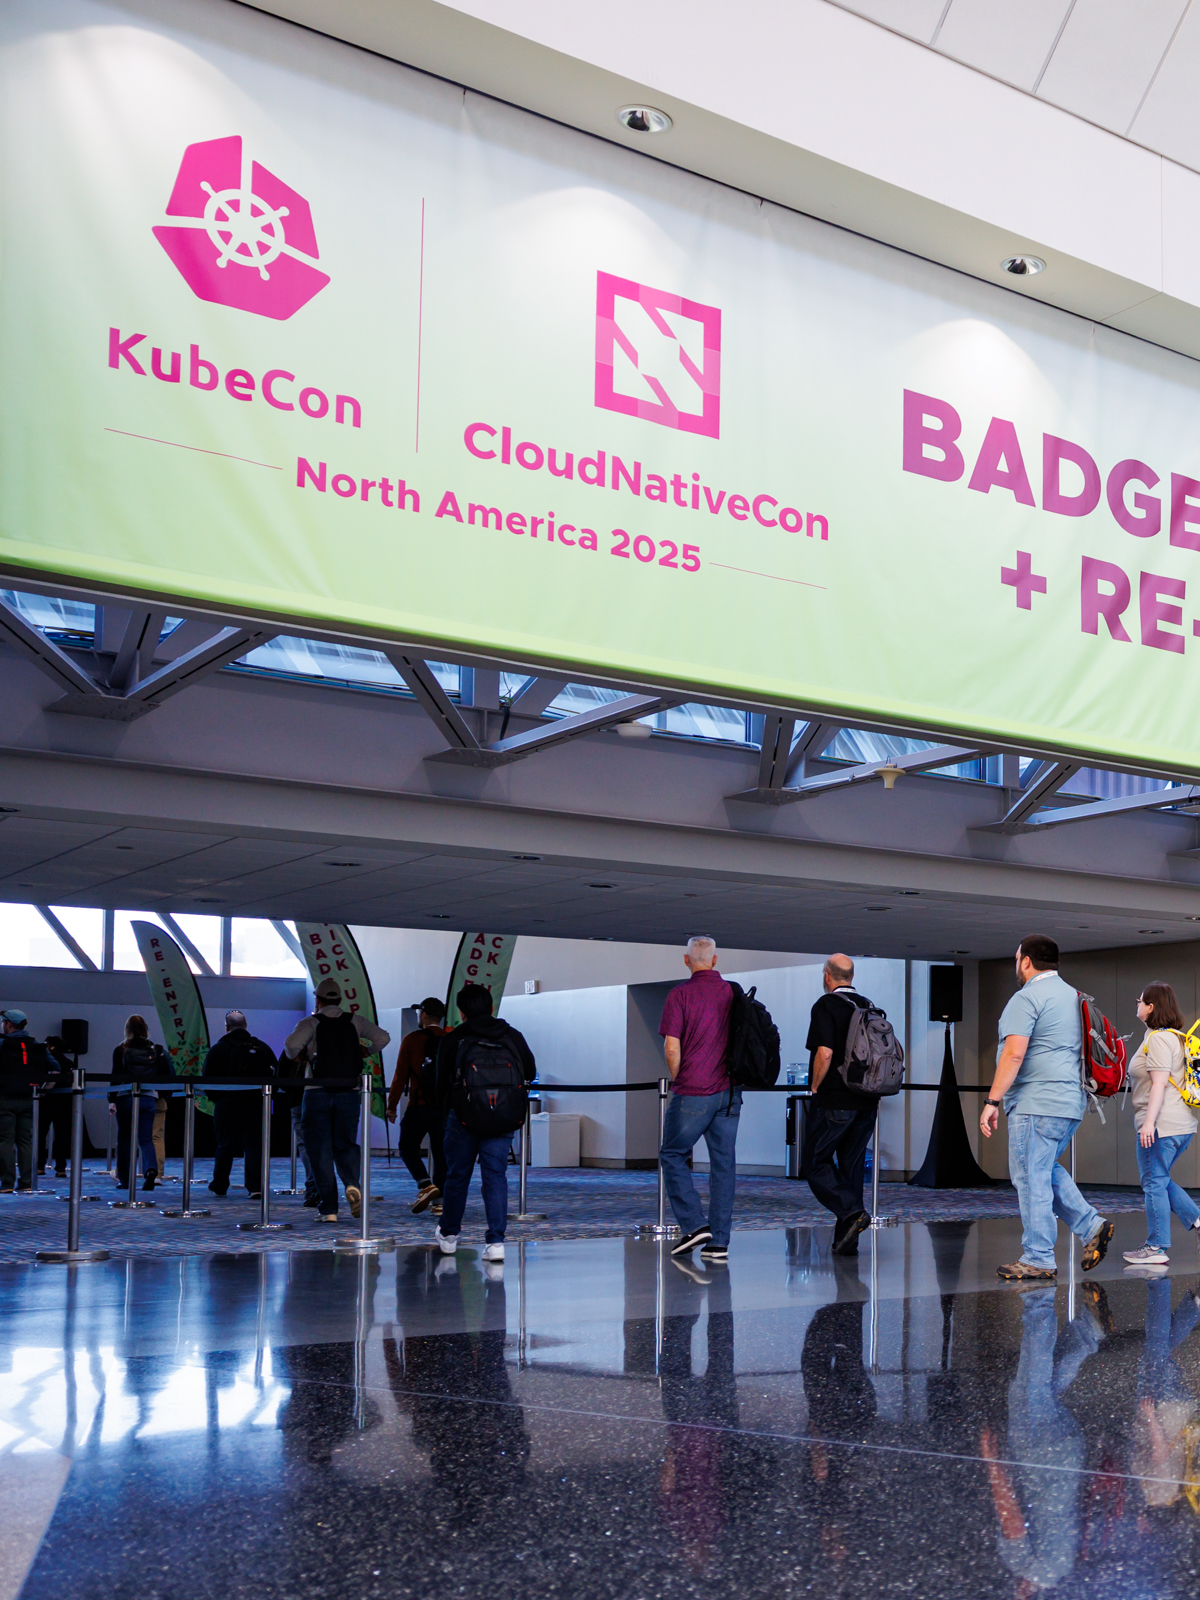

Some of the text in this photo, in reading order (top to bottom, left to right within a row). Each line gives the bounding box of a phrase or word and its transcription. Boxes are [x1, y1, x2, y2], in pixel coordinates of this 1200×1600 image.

[108, 327, 363, 430] KubeCon
[296, 456, 701, 574] North America 2025
[463, 422, 830, 542] CloudNativeCon
[1000, 550, 1048, 611] +
[149, 937, 186, 1041] RE-ENTRY
[323, 922, 361, 1015] ICK-UP
